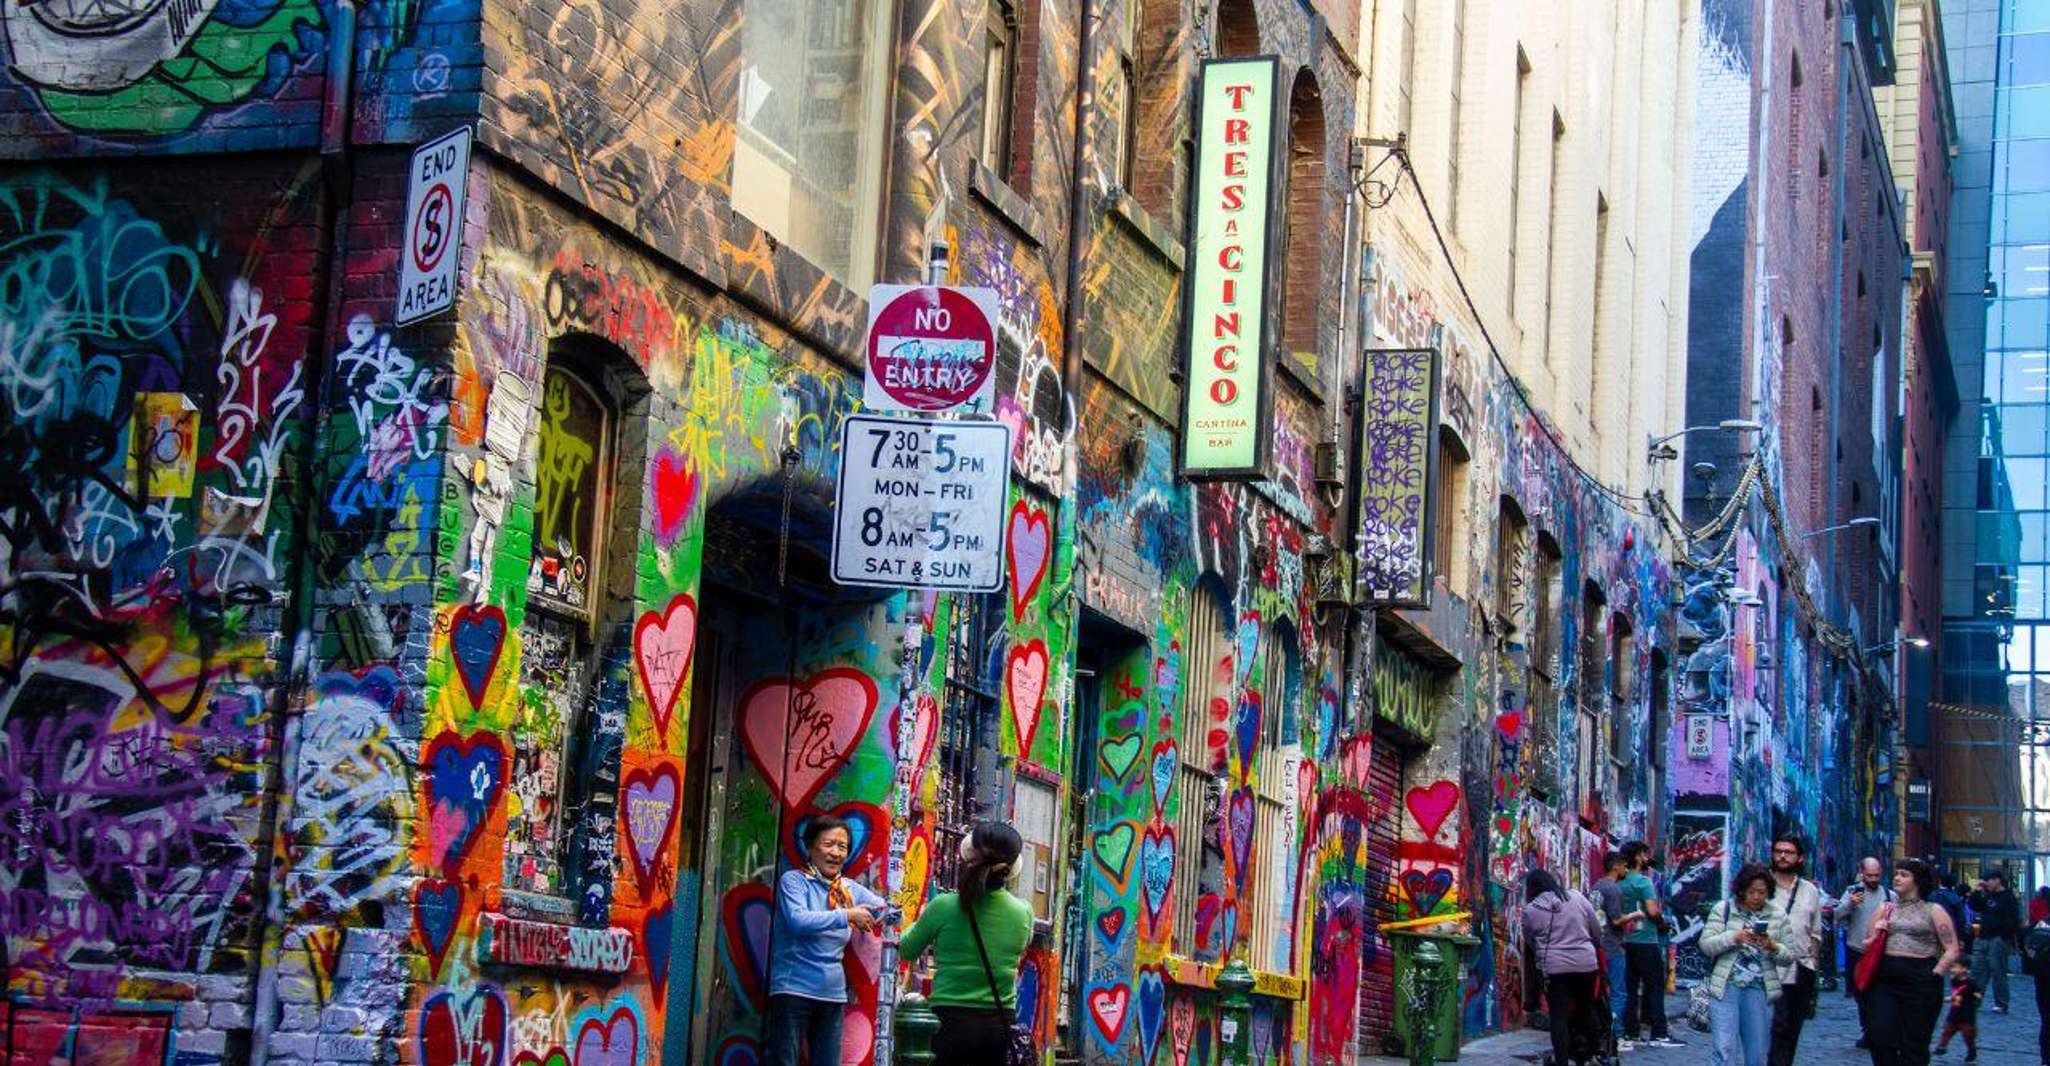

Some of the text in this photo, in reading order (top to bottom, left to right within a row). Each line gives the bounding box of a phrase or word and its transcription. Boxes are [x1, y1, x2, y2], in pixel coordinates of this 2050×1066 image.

[422, 145, 456, 182] END
[1222, 84, 1254, 213] TRES
[401, 275, 448, 314] AREA
[914, 307, 951, 332] NO
[1209, 244, 1243, 407] CINCO
[884, 364, 973, 392] ENTRY
[1195, 419, 1247, 428] CANTINA
[868, 429, 890, 469] 7
[892, 454, 919, 470] AM
[958, 456, 985, 473] PM
[1208, 439, 1232, 448] BAR
[875, 479, 919, 498] MON
[941, 483, 974, 501] FRI
[861, 507, 883, 548] 8
[886, 532, 914, 548] AM
[954, 534, 980, 550] PM
[865, 558, 971, 579] SAT & SUN
